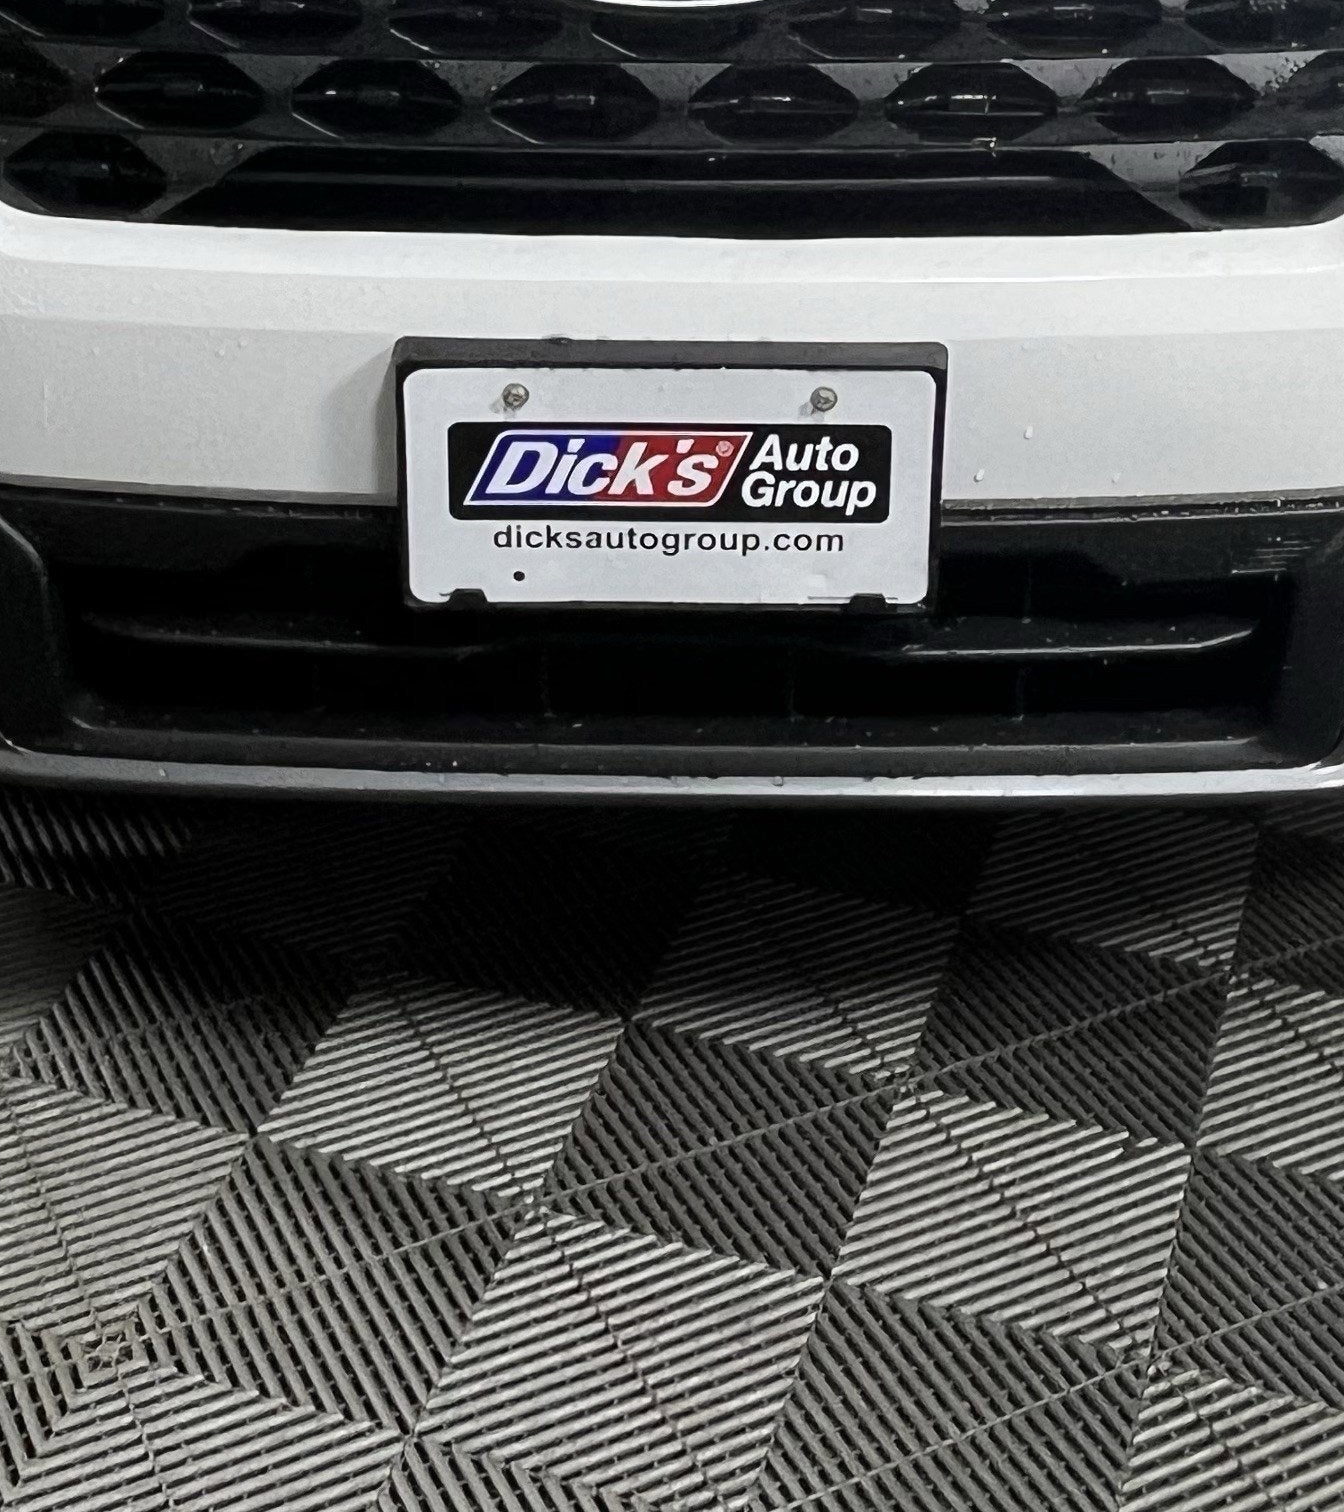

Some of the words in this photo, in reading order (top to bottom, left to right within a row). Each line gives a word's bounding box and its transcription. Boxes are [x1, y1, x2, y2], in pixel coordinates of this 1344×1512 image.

[485, 437, 720, 497] Dick's
[749, 433, 859, 472] Auto
[741, 473, 877, 516] Group
[492, 525, 845, 557] dicksautogroup.com
